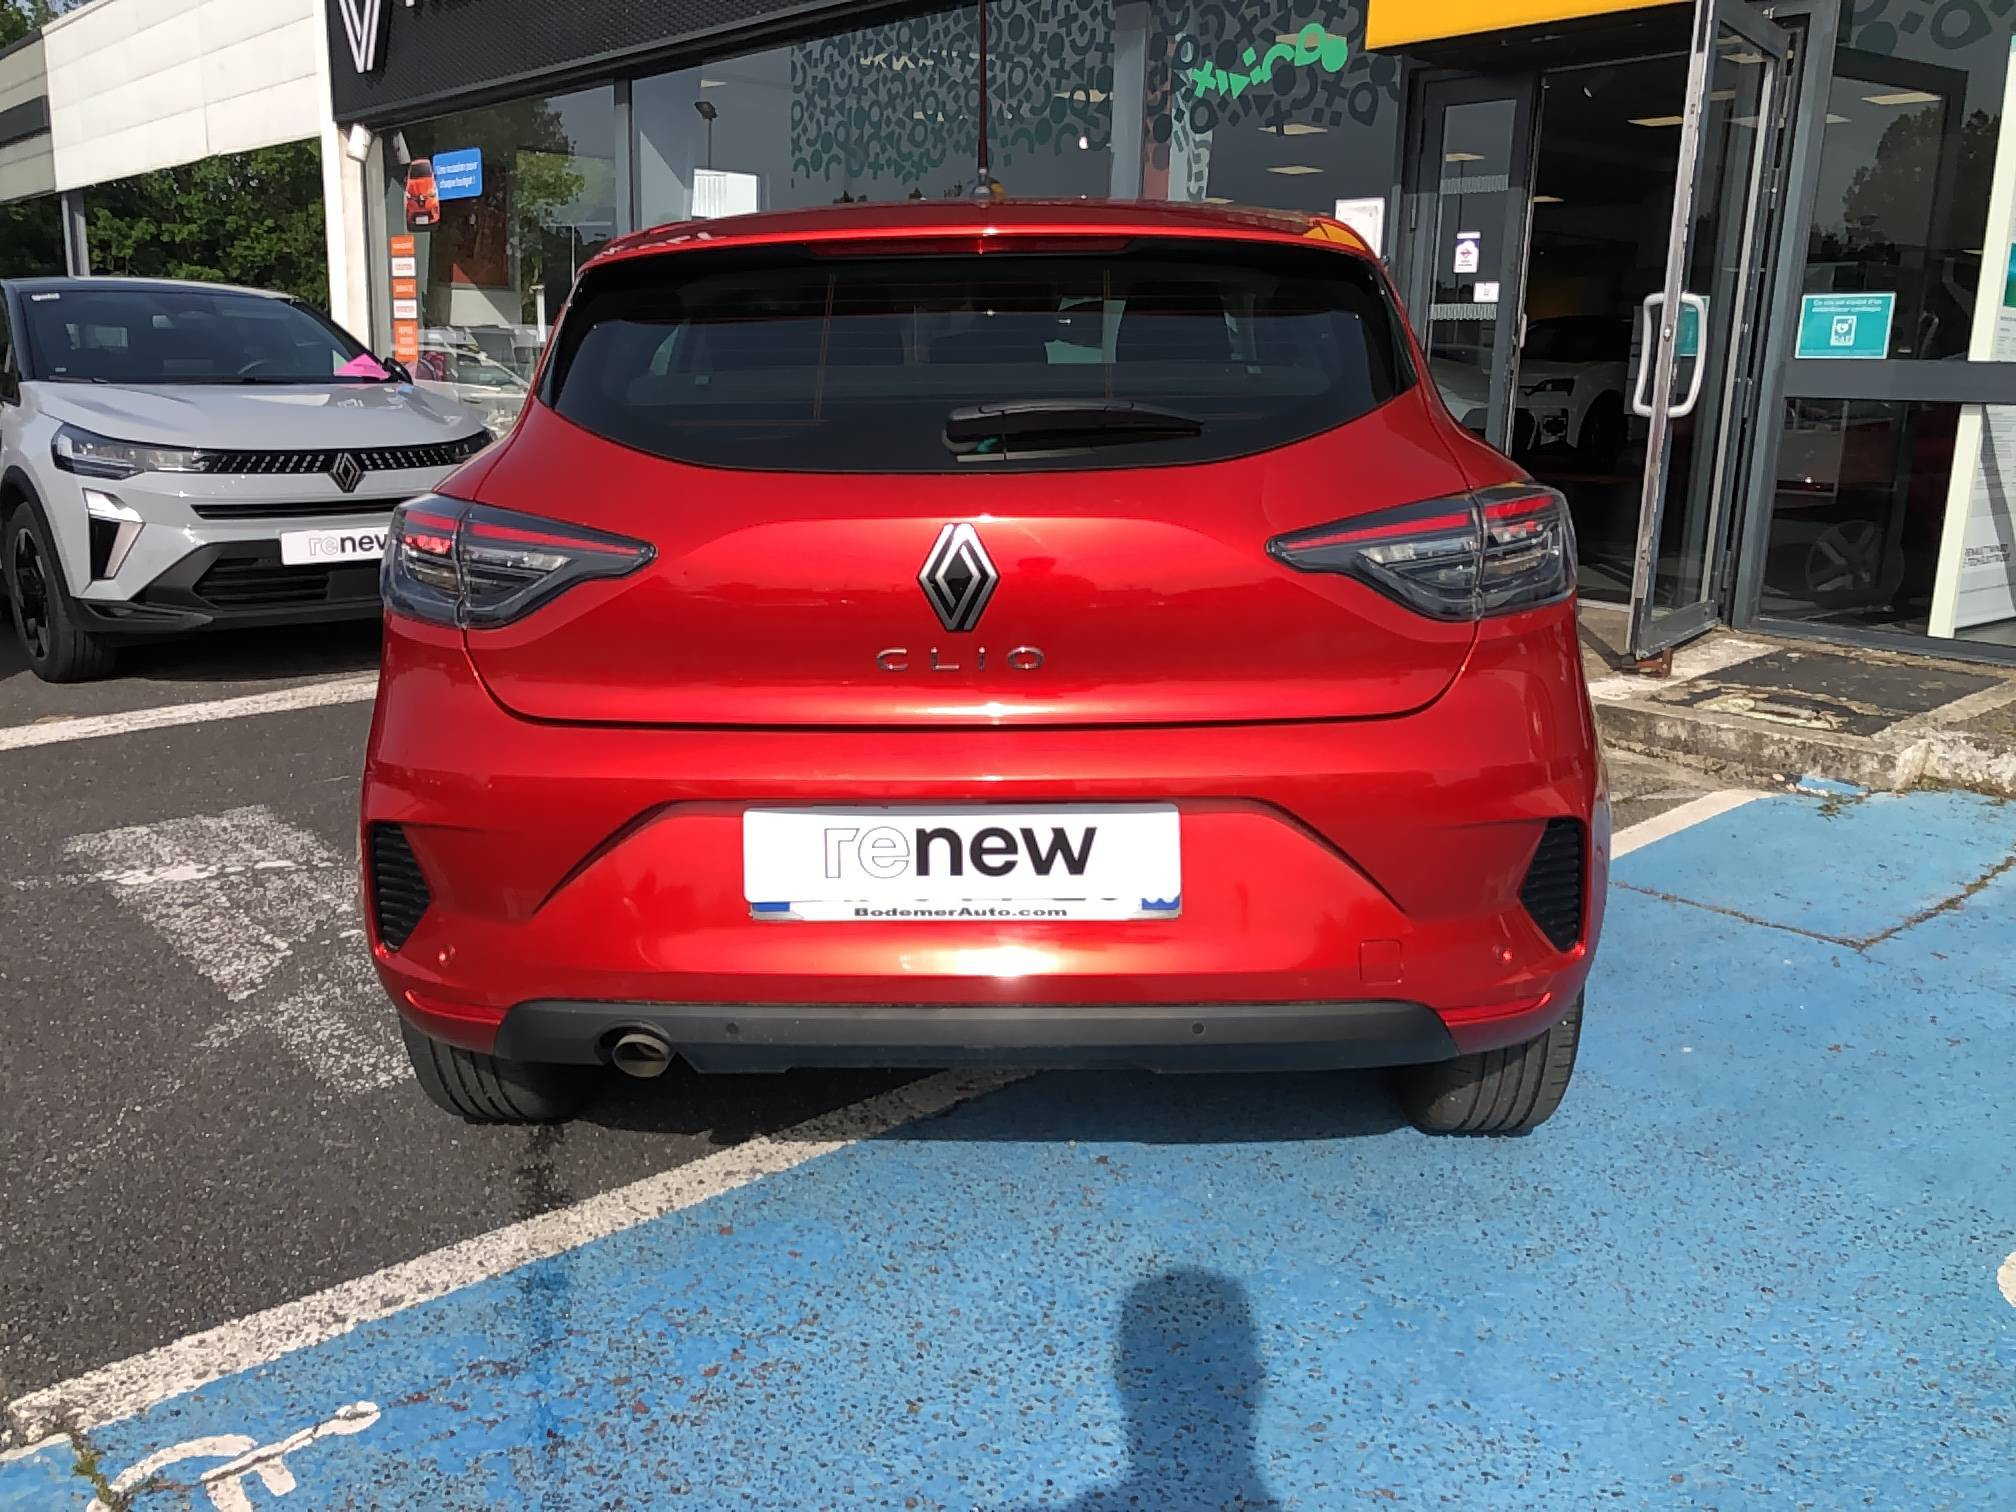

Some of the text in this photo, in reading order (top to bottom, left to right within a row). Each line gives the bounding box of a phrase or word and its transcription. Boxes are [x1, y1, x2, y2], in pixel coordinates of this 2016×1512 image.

[876, 646, 1045, 671] CLIO
[823, 826, 1097, 879] renew
[854, 907, 1068, 917] BodemerAuto.com
